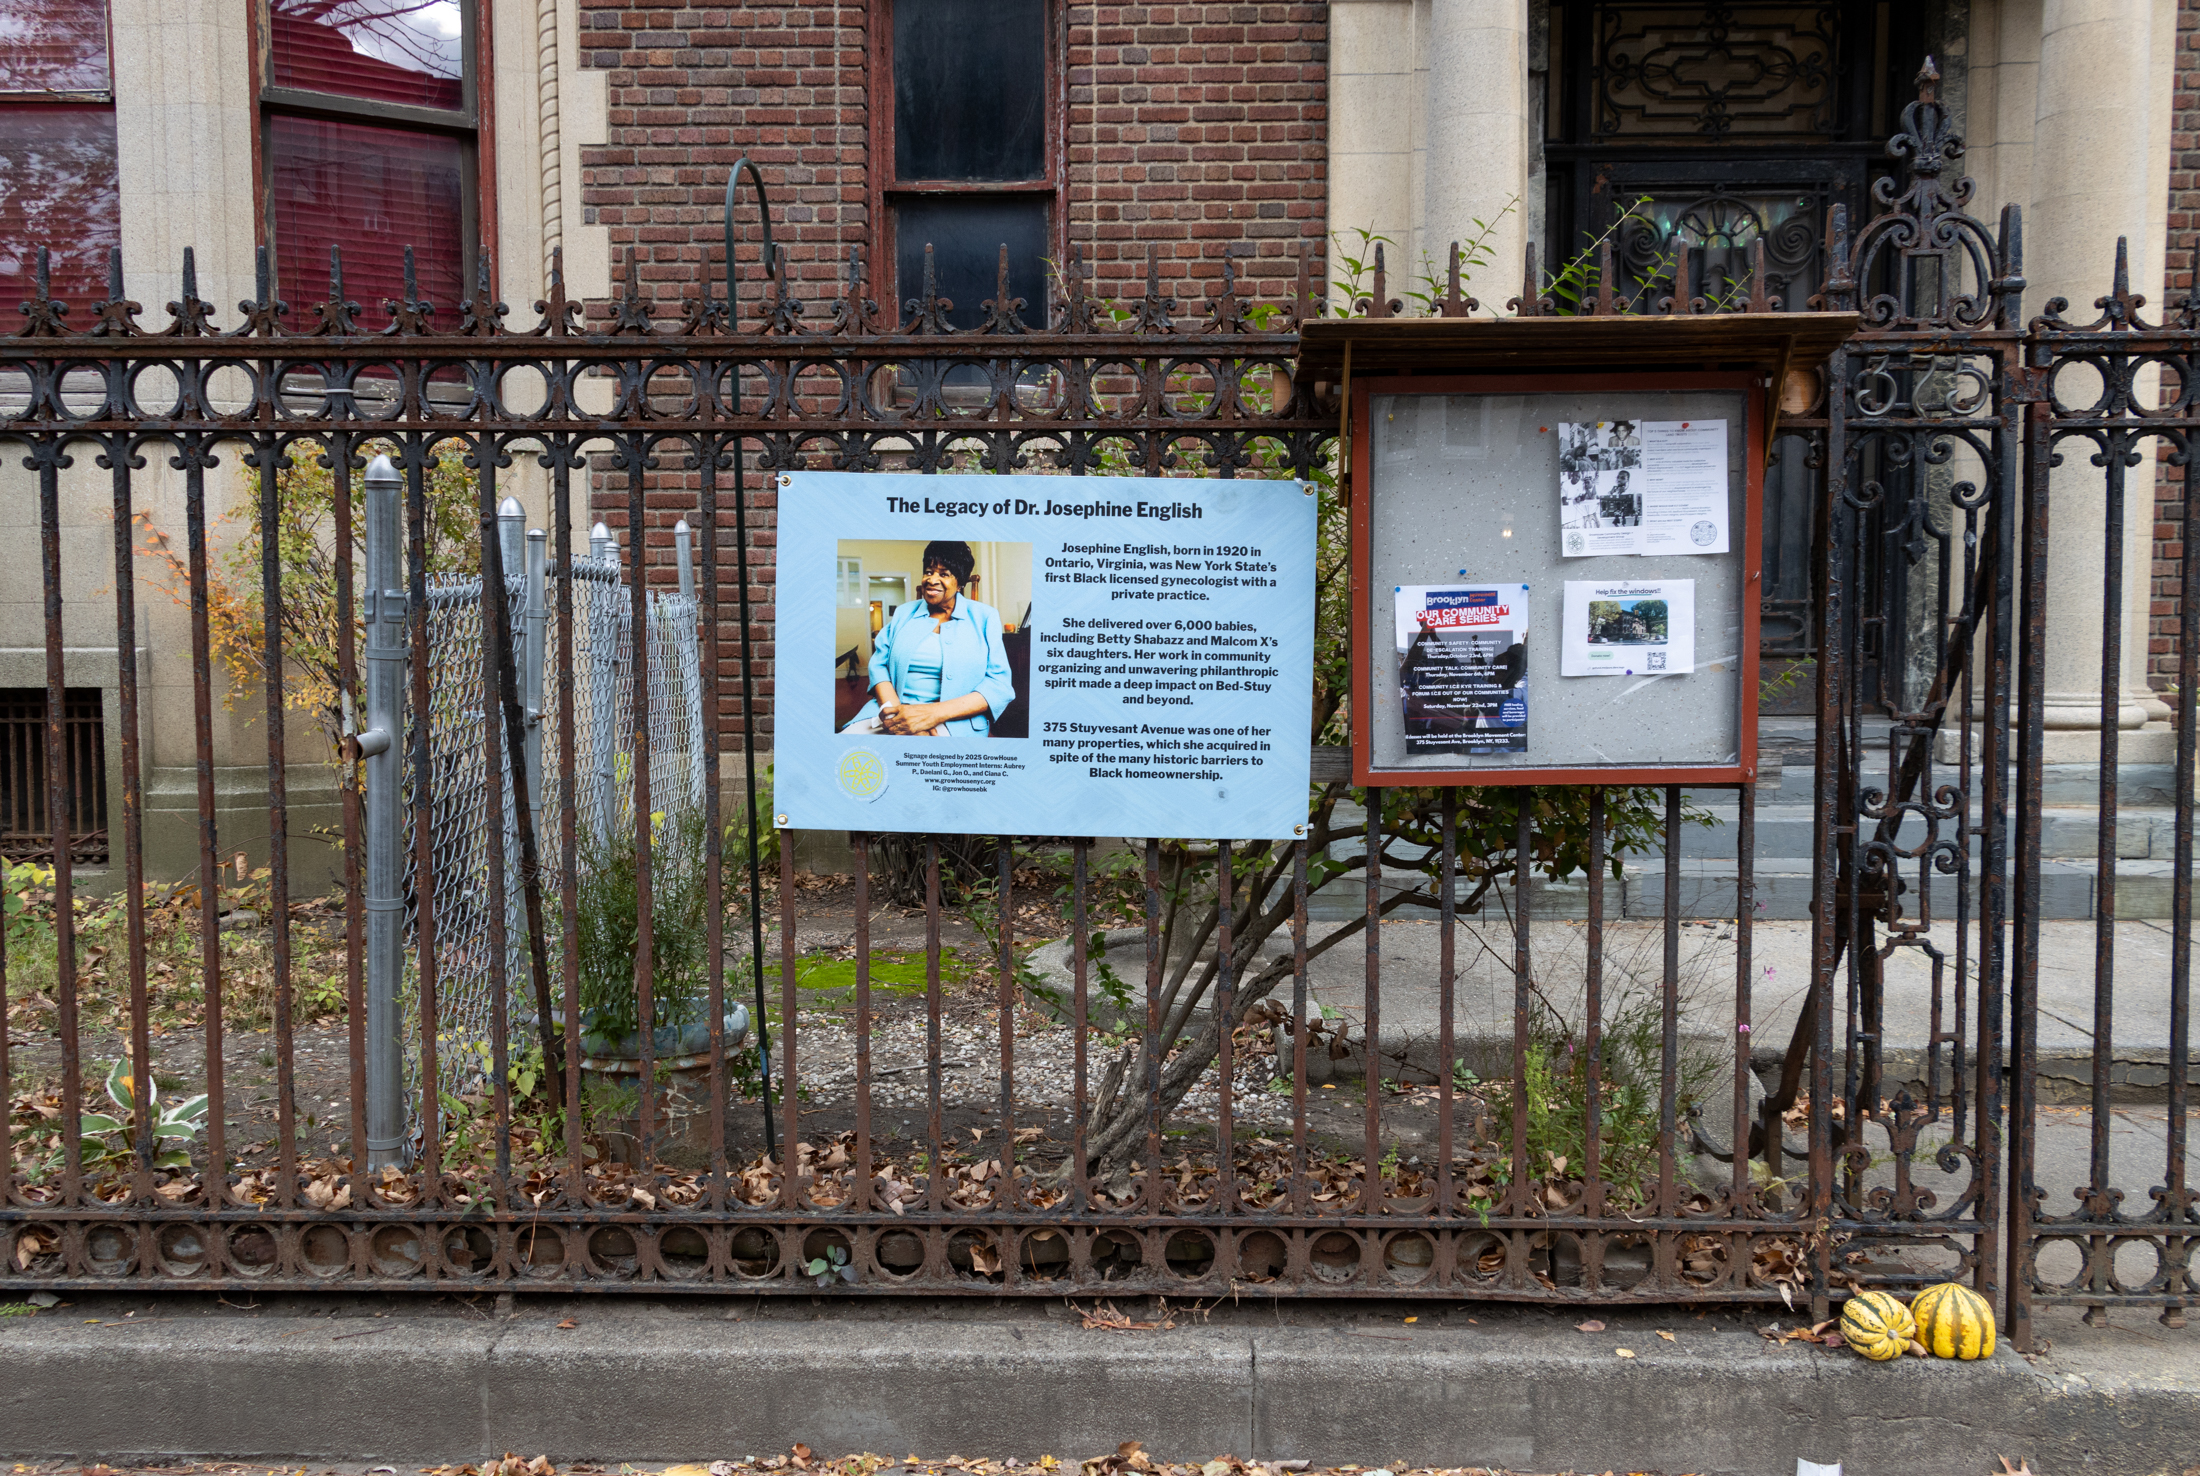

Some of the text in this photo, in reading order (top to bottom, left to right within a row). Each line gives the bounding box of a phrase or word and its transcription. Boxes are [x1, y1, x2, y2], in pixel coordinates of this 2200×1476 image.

[1854, 353, 1989, 419] 375
[886, 497, 1202, 521] The Legacy of Dr. Josephine English
[1062, 542, 1261, 556] Josephine English, born in 1920 in
[1045, 557, 1094, 570] Ontario,
[1096, 558, 1146, 571] Virginia,
[1149, 562, 1172, 570] was
[1176, 560, 1202, 570] New
[1204, 560, 1232, 571] York
[1045, 572, 1071, 582] first
[1074, 573, 1107, 583] Black
[1110, 574, 1158, 584] licensed
[1161, 576, 1239, 588] gynecologist
[1241, 576, 1267, 586] with
[1112, 589, 1210, 602] private practice.
[1426, 596, 1469, 606] Brooklyn
[1416, 605, 1509, 620] OUR COMMUNITY
[1062, 618, 1257, 633] She delivered over 6,000 babies,
[1427, 614, 1500, 627] CARE SERIES:
[1040, 632, 1094, 645] including
[1097, 633, 1131, 646] Betty
[1134, 634, 1184, 645] Shabazz
[1186, 636, 1208, 646] and
[1211, 636, 1257, 646] Malcom
[1047, 648, 1271, 664] six daughters. Her work in community
[1038, 663, 1278, 678] organizing and unwavering philanthropic
[1045, 678, 1076, 689] spirit
[1079, 678, 1112, 688] made
[1124, 679, 1152, 691] deep
[1155, 680, 1196, 692] impact
[1216, 680, 1272, 693] Bed-Stuy
[1122, 694, 1193, 706] and beyond.
[1043, 722, 1067, 732] 375
[1070, 722, 1138, 735] Stuyvesant
[1140, 724, 1185, 734] Avenue
[1213, 728, 1235, 736] one
[1237, 726, 1249, 736] of
[1252, 726, 1271, 736] her
[1043, 738, 1270, 752] many properties, which she acquired in
[904, 752, 928, 760] Signage
[1050, 752, 1263, 766] spite of the many historic barriers to
[924, 778, 996, 786] www.growhousenyc.org
[1090, 768, 1223, 782] Black homeownership.
